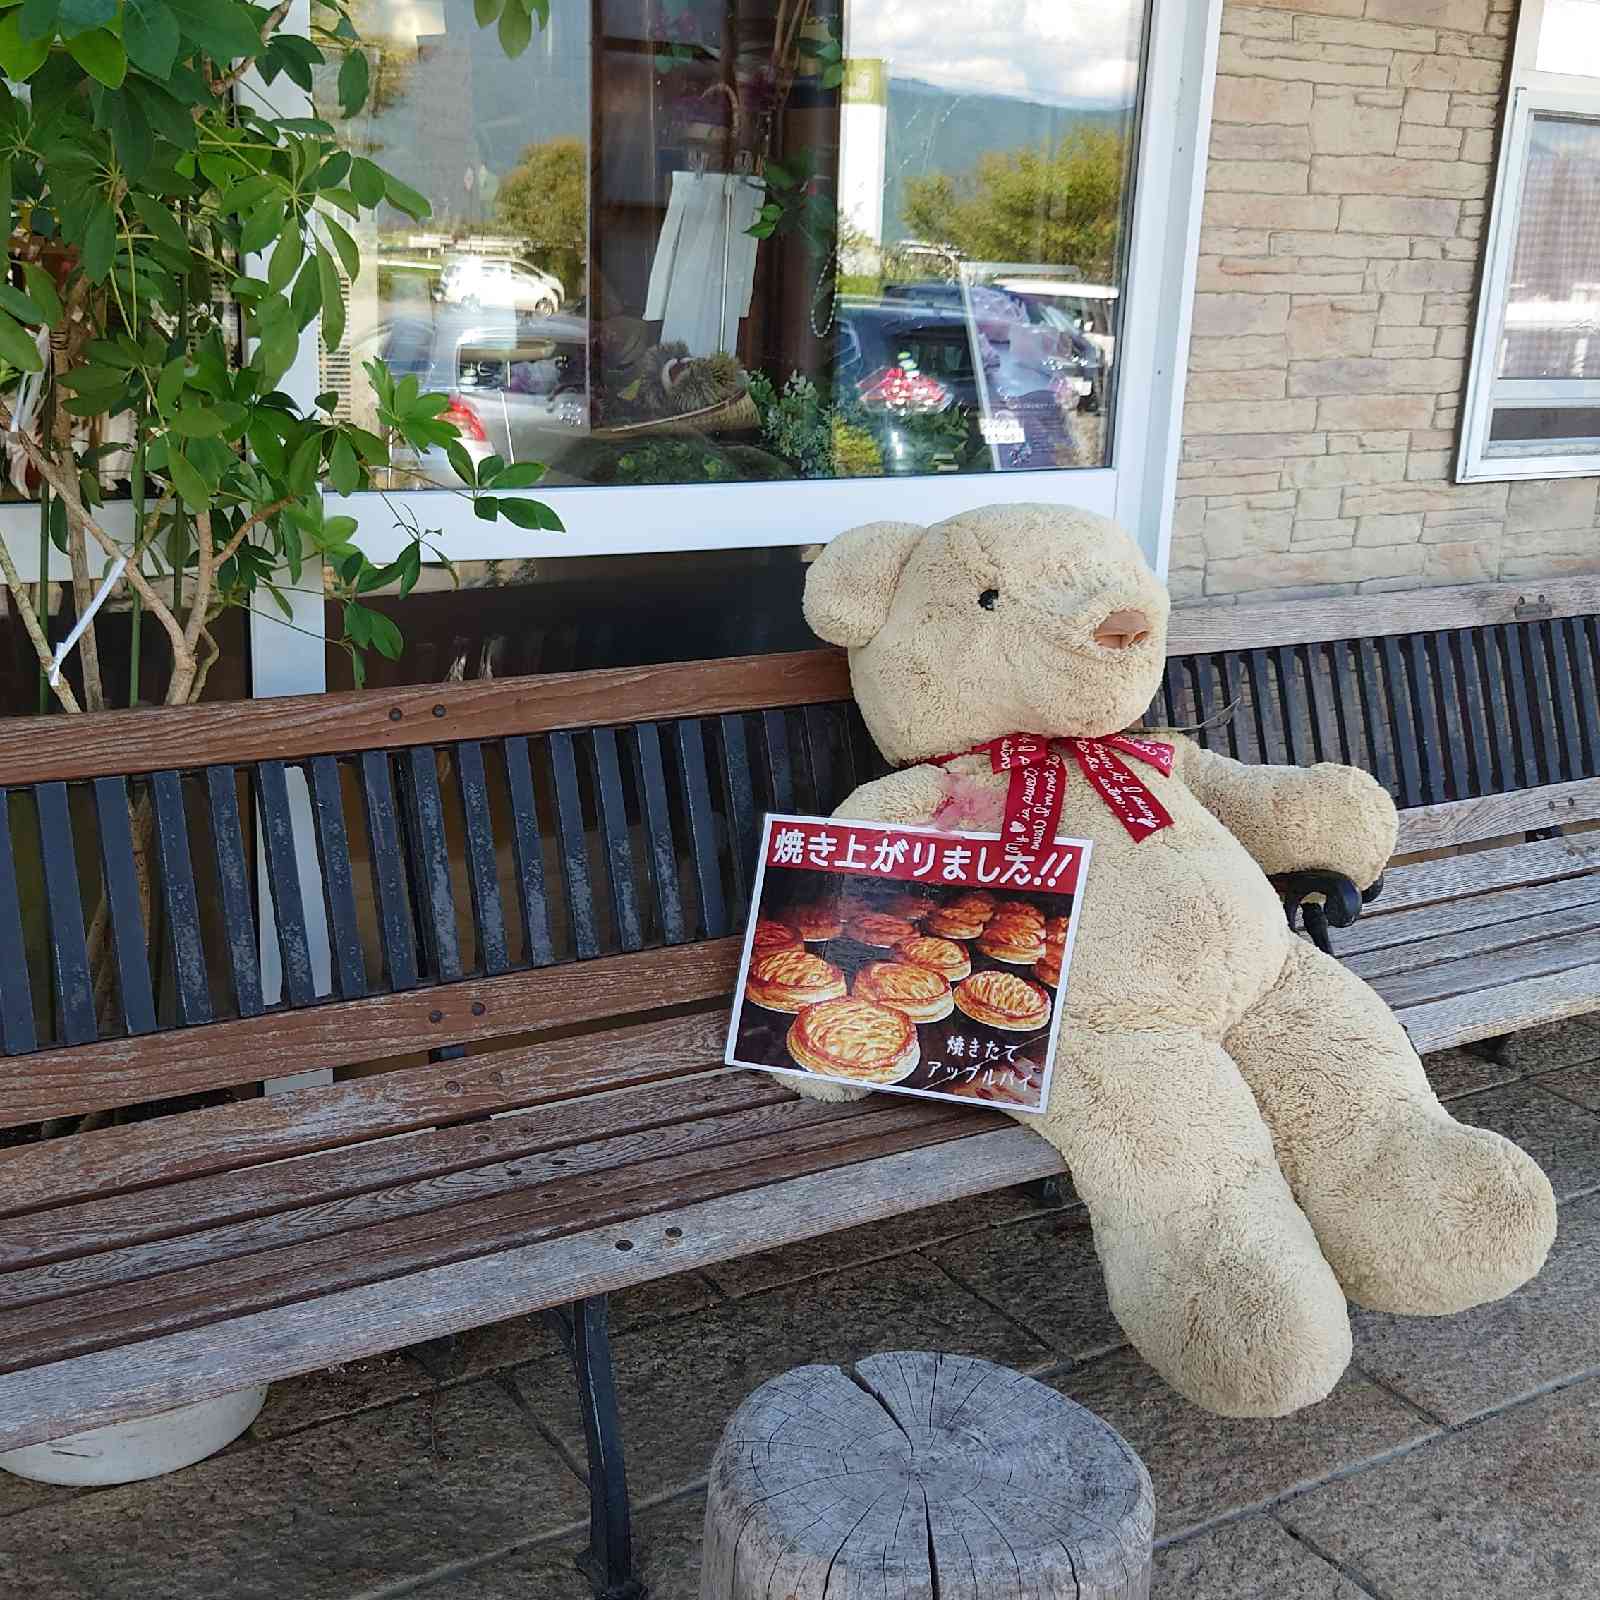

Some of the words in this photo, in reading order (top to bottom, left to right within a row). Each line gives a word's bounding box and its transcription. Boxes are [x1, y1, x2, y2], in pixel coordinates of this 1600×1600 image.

[946, 1035, 1020, 1063] 焼きたて
[927, 1061, 1033, 1092] アップルパイ
